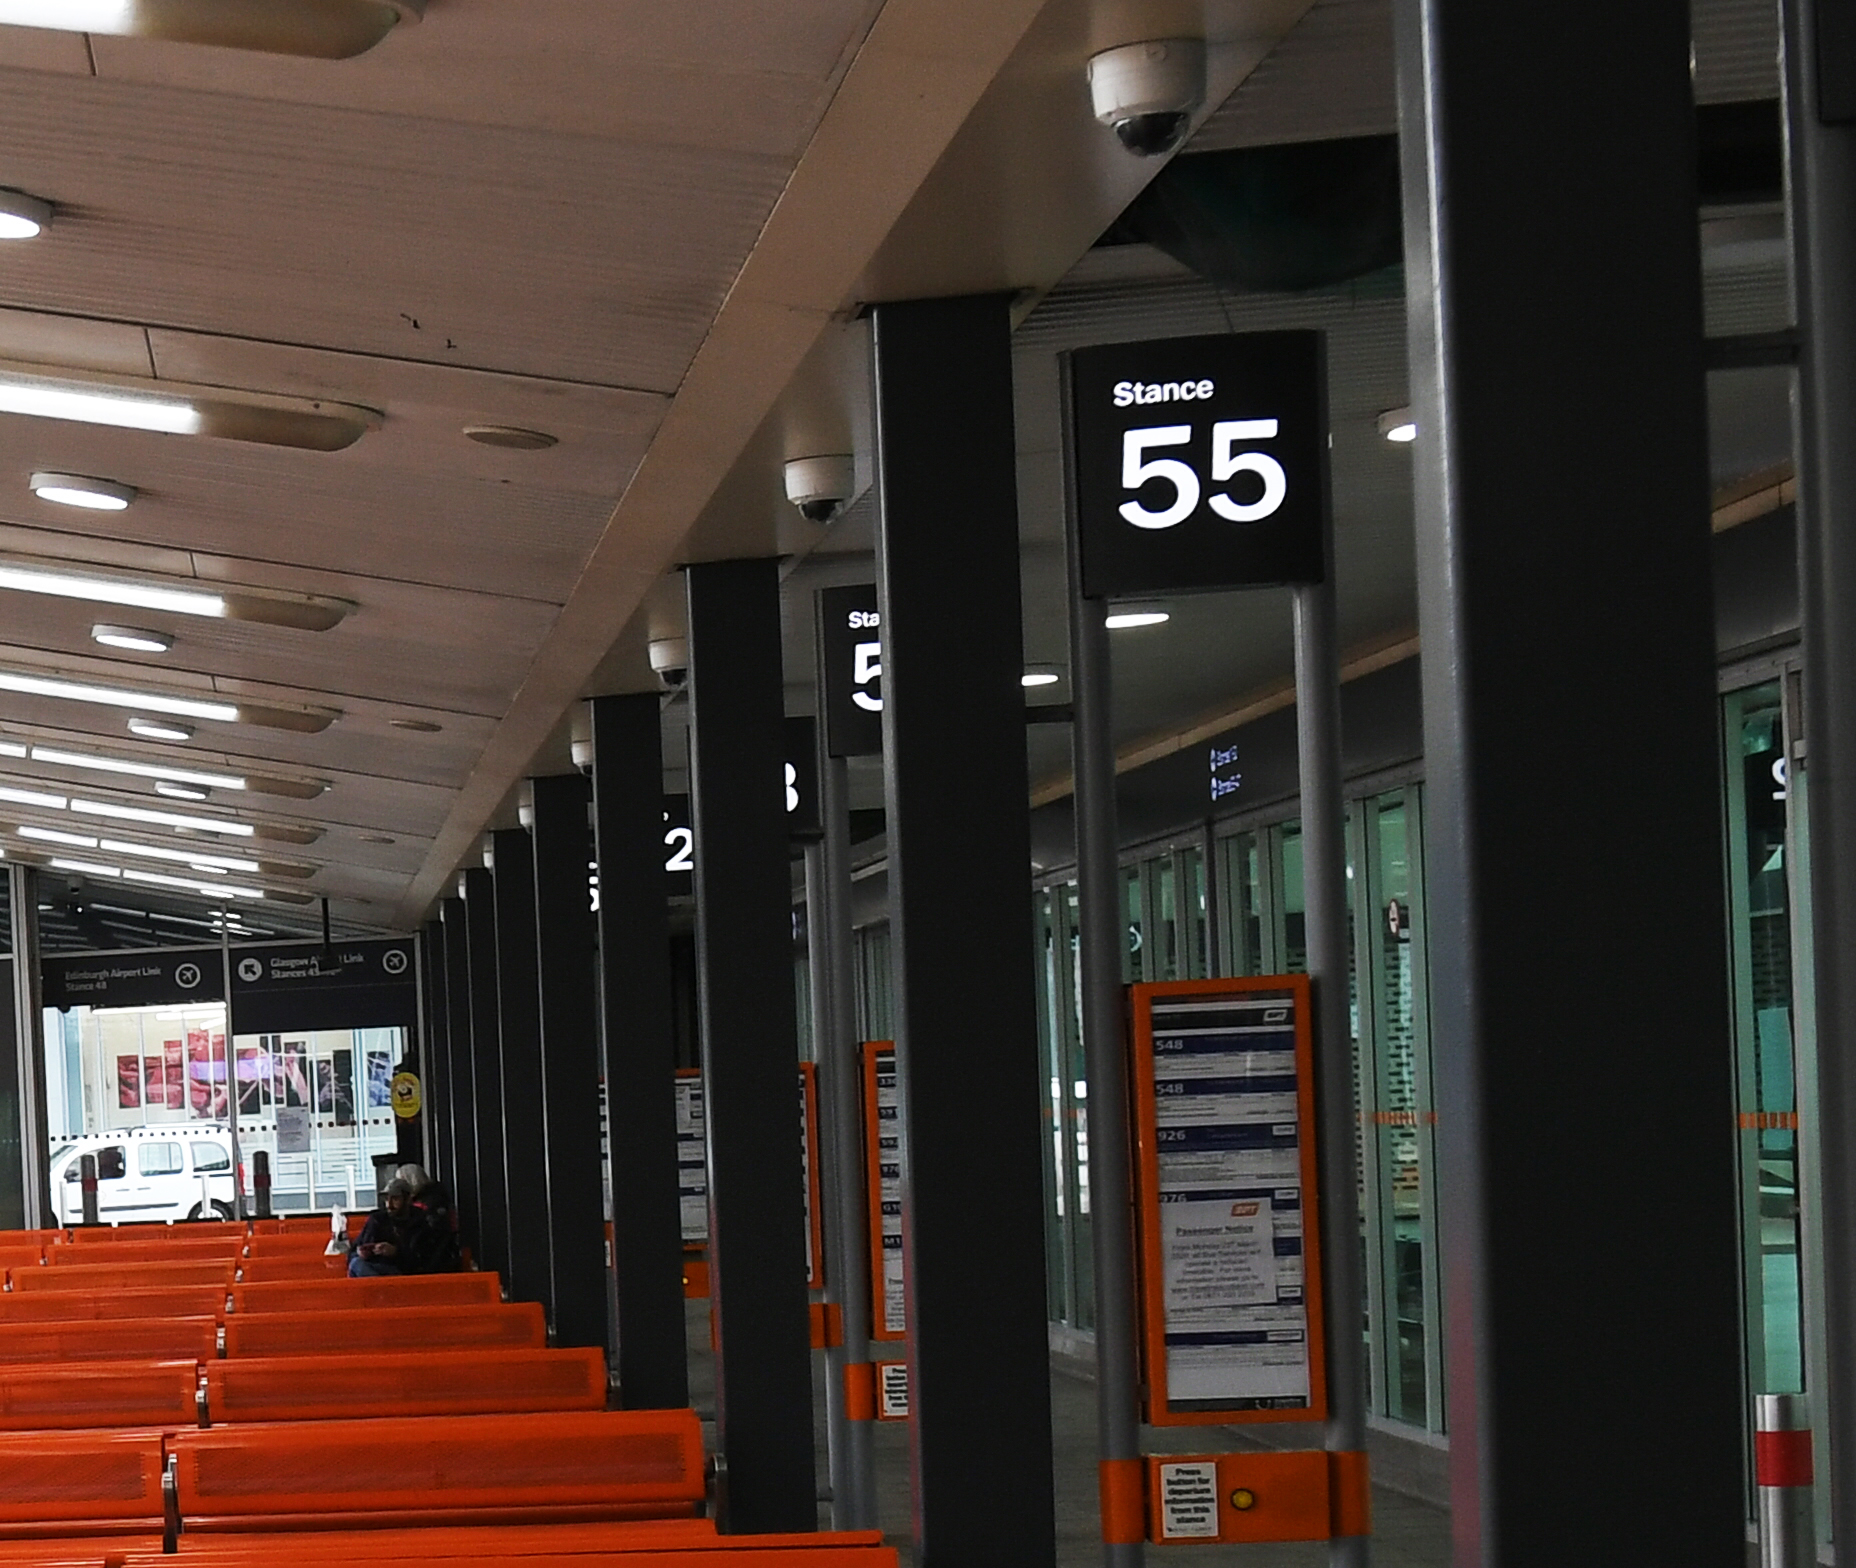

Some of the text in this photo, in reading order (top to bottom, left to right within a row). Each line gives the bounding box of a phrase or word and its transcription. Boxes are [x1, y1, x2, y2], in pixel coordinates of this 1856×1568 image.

[1113, 379, 1214, 407] Stance
[1118, 418, 1287, 529] 55
[848, 610, 881, 629] Sta
[852, 642, 884, 711] 5
[664, 828, 694, 871] 2
[270, 957, 309, 969] Glasgow
[65, 966, 162, 981] Edinburgh Airport Link
[65, 982, 95, 992] Stance
[1155, 1039, 1184, 1051] 548
[1155, 1083, 1185, 1095] 548
[1158, 1129, 1187, 1141] 926
[1175, 1225, 1254, 1238] Passenger Notice
[1175, 1467, 1201, 1476] Press
[1166, 1477, 1210, 1486] button for
[1168, 1487, 1211, 1496] departure
[1164, 1496, 1215, 1505] information
[1170, 1505, 1210, 1514] from this
[1175, 1515, 1206, 1524] stance
